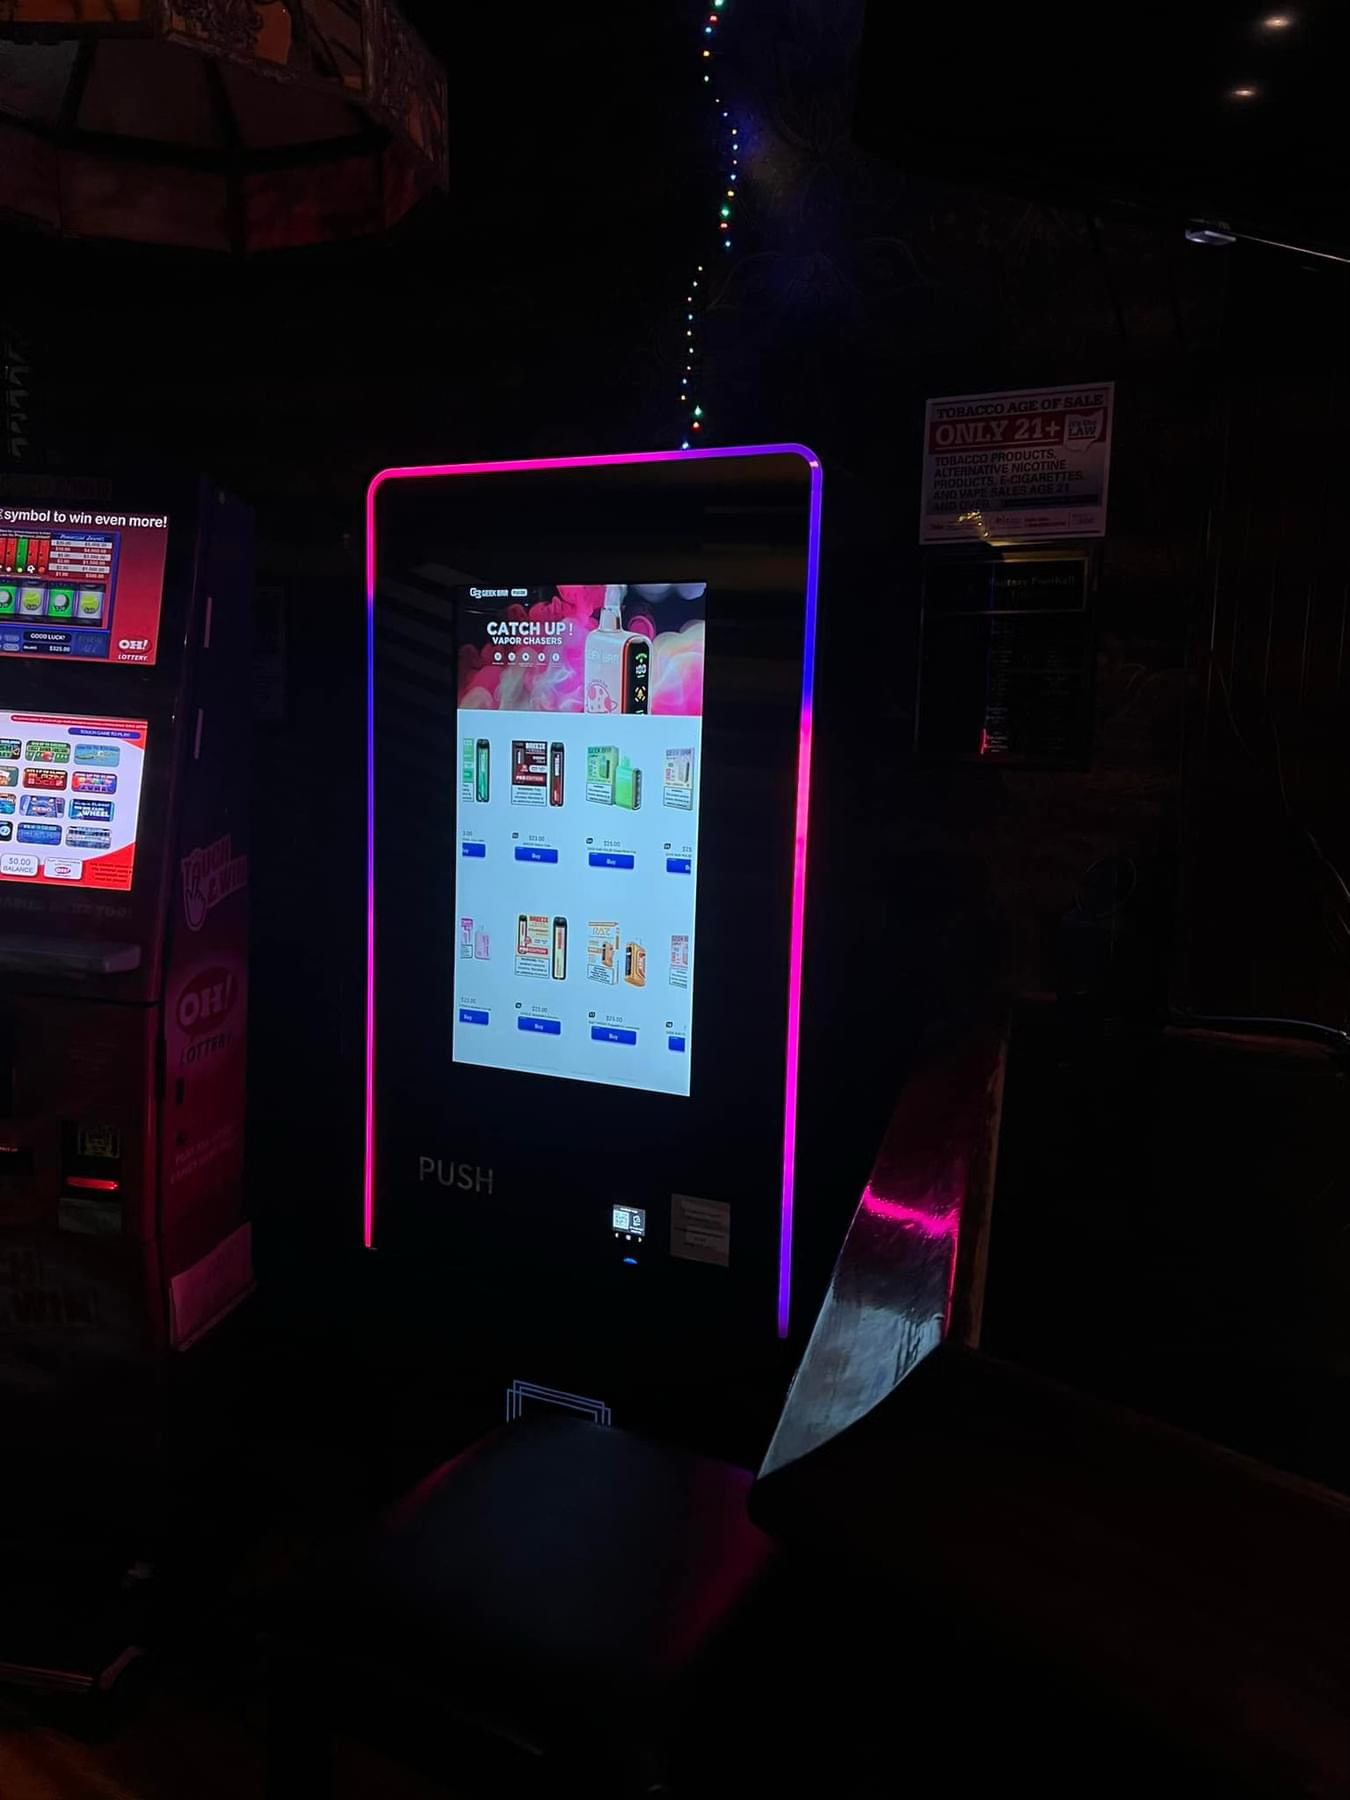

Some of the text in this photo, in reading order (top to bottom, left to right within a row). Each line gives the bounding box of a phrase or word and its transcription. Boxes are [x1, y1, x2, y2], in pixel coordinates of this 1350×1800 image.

[937, 394, 1104, 418] TOBACCO AGE OF SALE
[935, 416, 1061, 446] ONLY 21+
[935, 454, 988, 466] TOBACCO
[934, 459, 1067, 478] ALTERNATIVE NICOTINE
[959, 487, 987, 499] VAPE
[991, 485, 1026, 497] SALES
[1029, 484, 1056, 495] AGE
[4, 509, 168, 528] symbol to win even more!
[486, 621, 540, 636] CATCH
[118, 639, 149, 651] OH!
[492, 637, 562, 646] VAPOR CHASERS
[118, 653, 149, 661] LOTTERY
[8, 857, 31, 866] $0.00
[418, 1154, 495, 1196] PUSH
